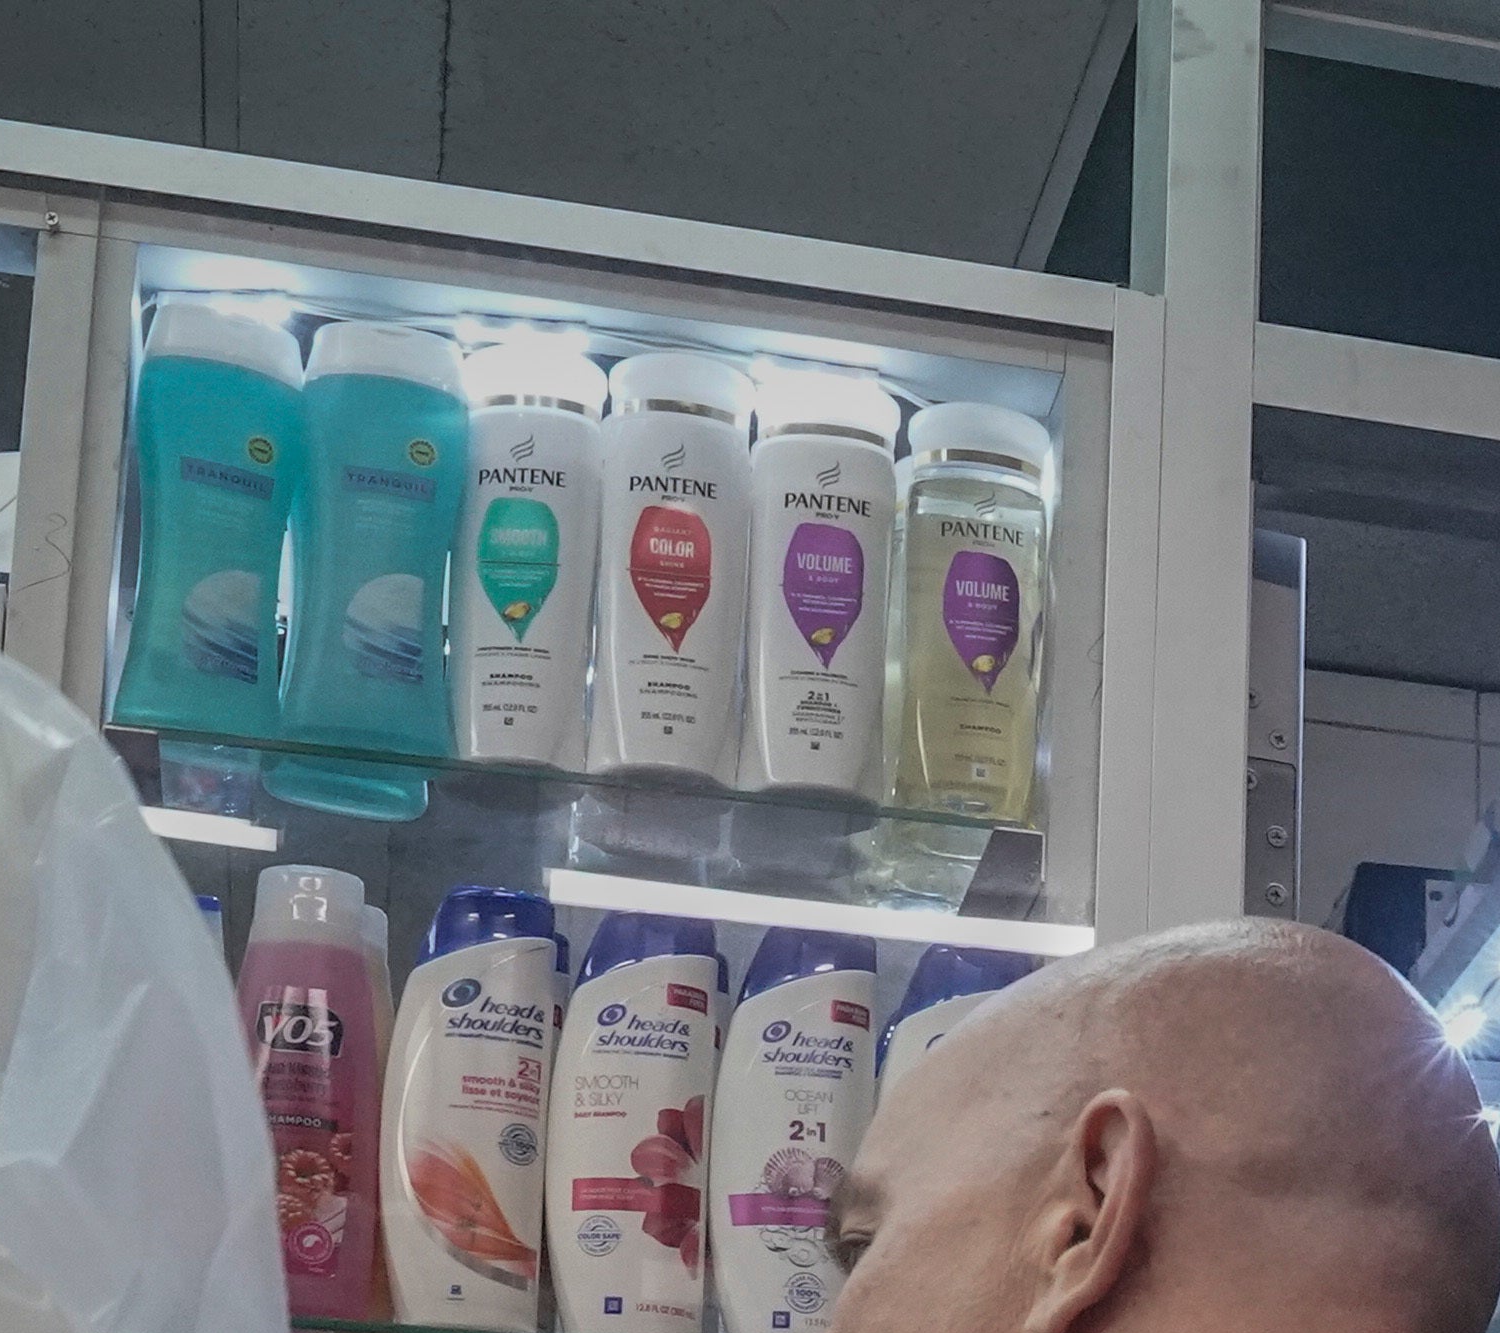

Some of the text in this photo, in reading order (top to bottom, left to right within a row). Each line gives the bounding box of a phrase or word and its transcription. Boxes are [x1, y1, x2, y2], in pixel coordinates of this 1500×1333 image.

[186, 464, 269, 494] TRANQUIL
[346, 471, 428, 495] TRANQUIL
[478, 467, 566, 488] PANTENE
[629, 475, 718, 500] PANTENE
[784, 492, 871, 517] PANTENE
[940, 520, 1025, 547] PANTENE
[650, 537, 695, 559] COLOR
[797, 552, 853, 575] VOLUME
[816, 576, 840, 584] BODY
[955, 579, 1010, 602] VOLUME
[447, 1014, 544, 1041] shoulders
[596, 1032, 690, 1053] shoulders
[762, 1048, 854, 1069] shoulders
[461, 1084, 489, 1096] lisse
[462, 1074, 506, 1087] smooth
[575, 1074, 640, 1090] SMOOTH
[575, 1092, 624, 1107] & SILKY
[785, 1088, 834, 1104] OCEAN
[797, 1103, 818, 1116] LIFT
[268, 1113, 322, 1130] HAMPOO
